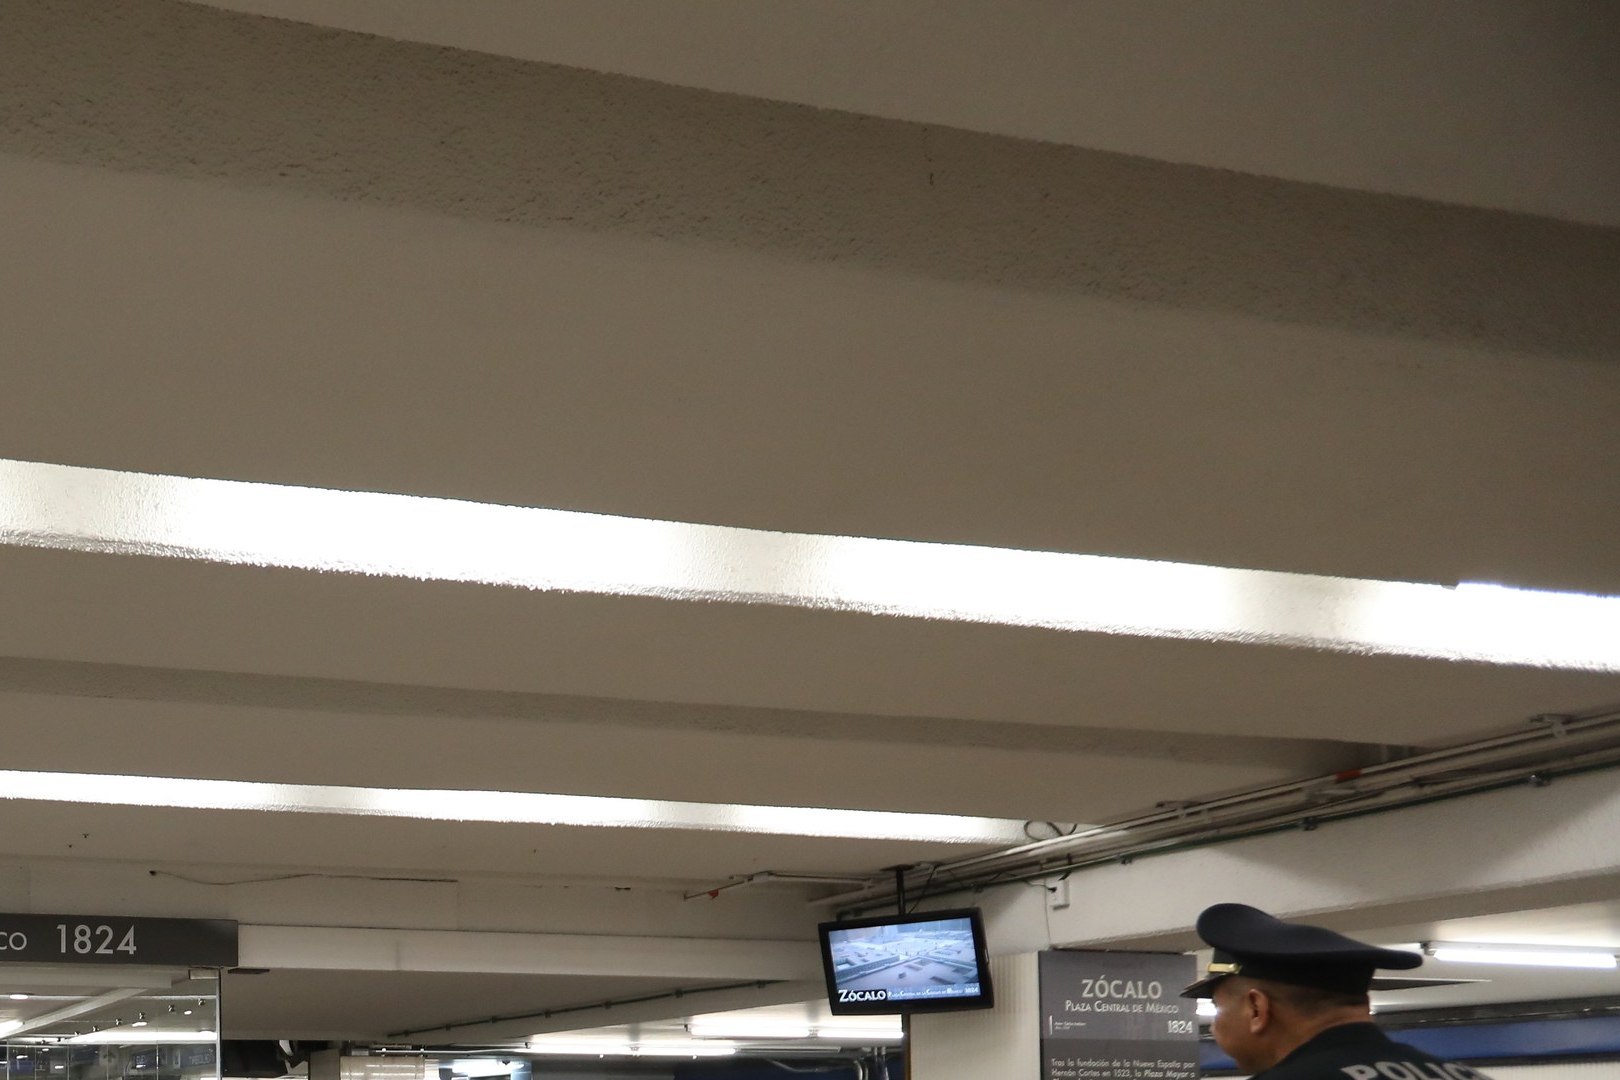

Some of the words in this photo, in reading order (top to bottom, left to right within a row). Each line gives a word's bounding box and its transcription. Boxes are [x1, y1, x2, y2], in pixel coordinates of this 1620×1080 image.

[56, 924, 137, 955] 1824
[1082, 975, 1162, 999] ZÓCALO
[838, 989, 887, 1002] ZÓCALO
[1065, 1000, 1091, 1011] PLAZA
[1094, 1000, 1130, 1012] CENTRAL
[1133, 1004, 1143, 1012] DE
[1145, 1002, 1179, 1013] MÉXICO
[1167, 1020, 1193, 1033] 1824
